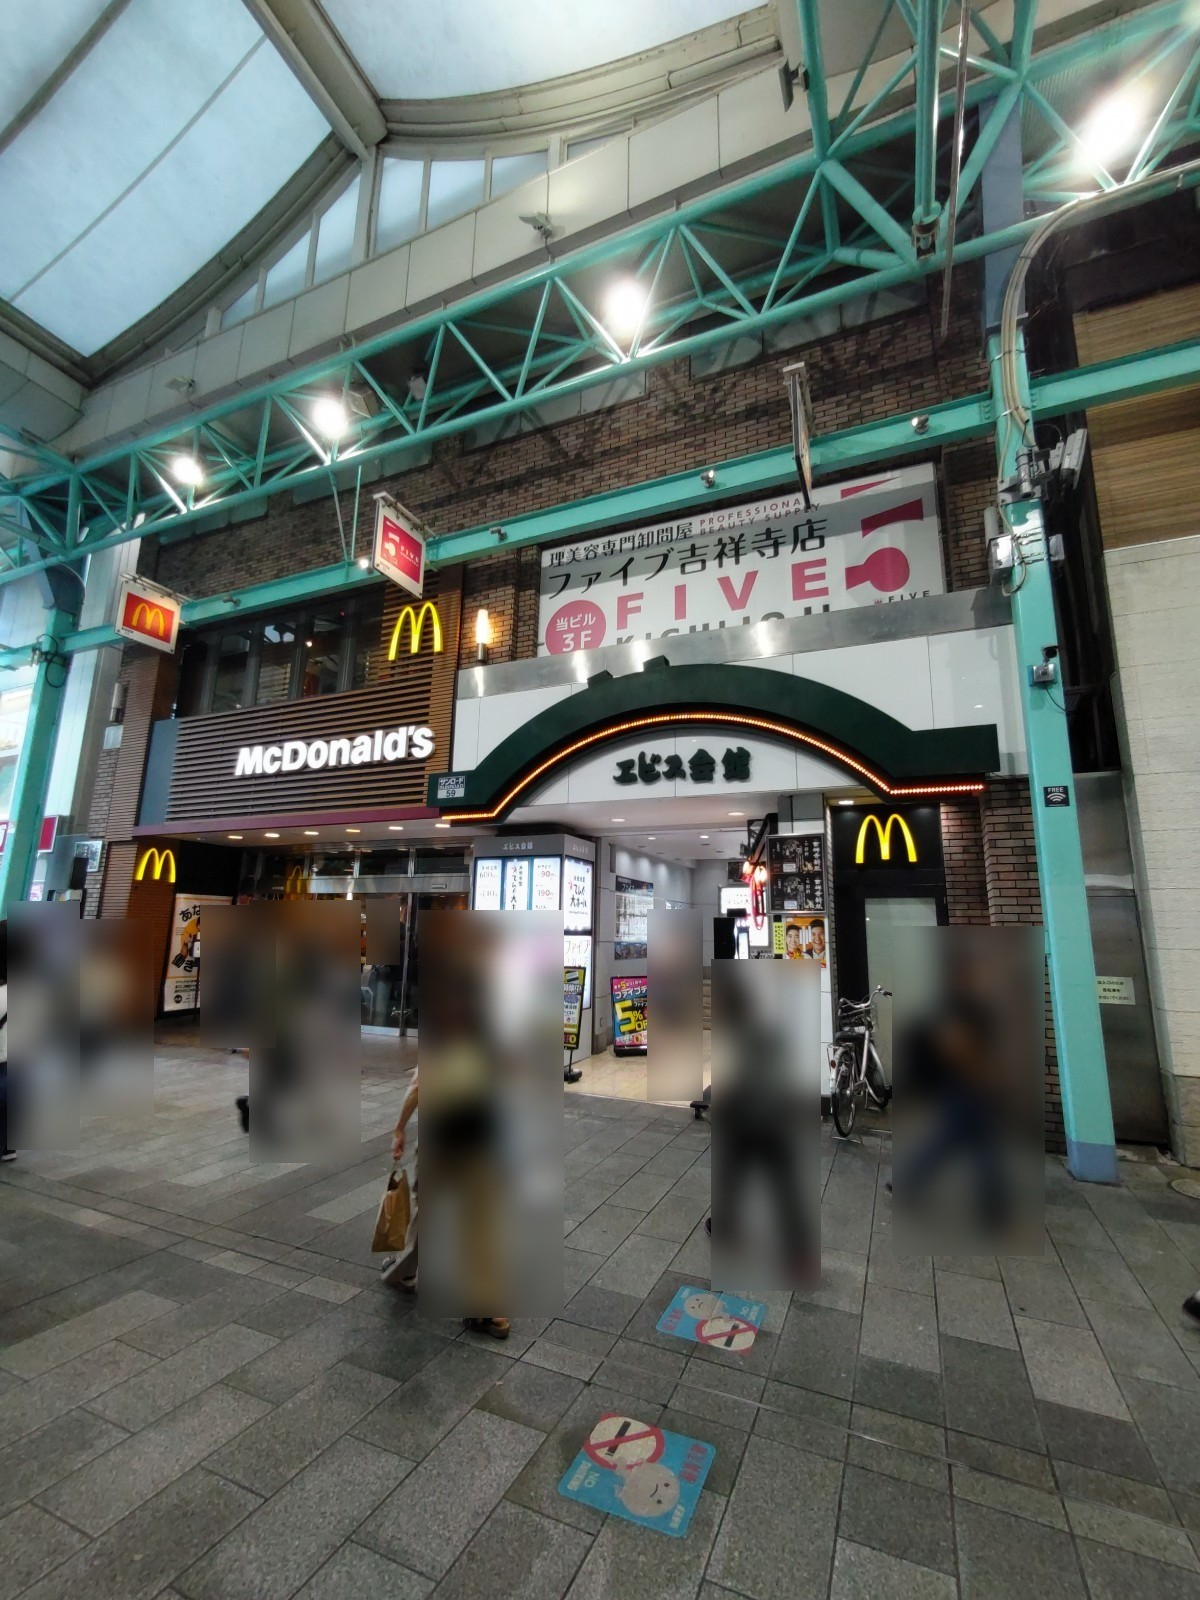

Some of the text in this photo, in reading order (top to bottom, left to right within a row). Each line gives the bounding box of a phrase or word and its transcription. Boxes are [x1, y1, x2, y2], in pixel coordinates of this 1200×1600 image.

[699, 498, 800, 526] PROFESSIONA
[700, 516, 756, 536] BEAUTY
[549, 521, 692, 568] 理美容専門卸問屋
[548, 518, 828, 600] ファイブ吉祥寺店
[616, 557, 830, 631] FIVE
[888, 589, 930, 603] FIVE
[555, 612, 596, 632] 当ビル
[562, 630, 593, 652] 3F
[235, 725, 436, 776] McDonald's
[612, 746, 751, 783] エビス会館
[440, 777, 464, 787] サンロード
[446, 790, 456, 798] 59
